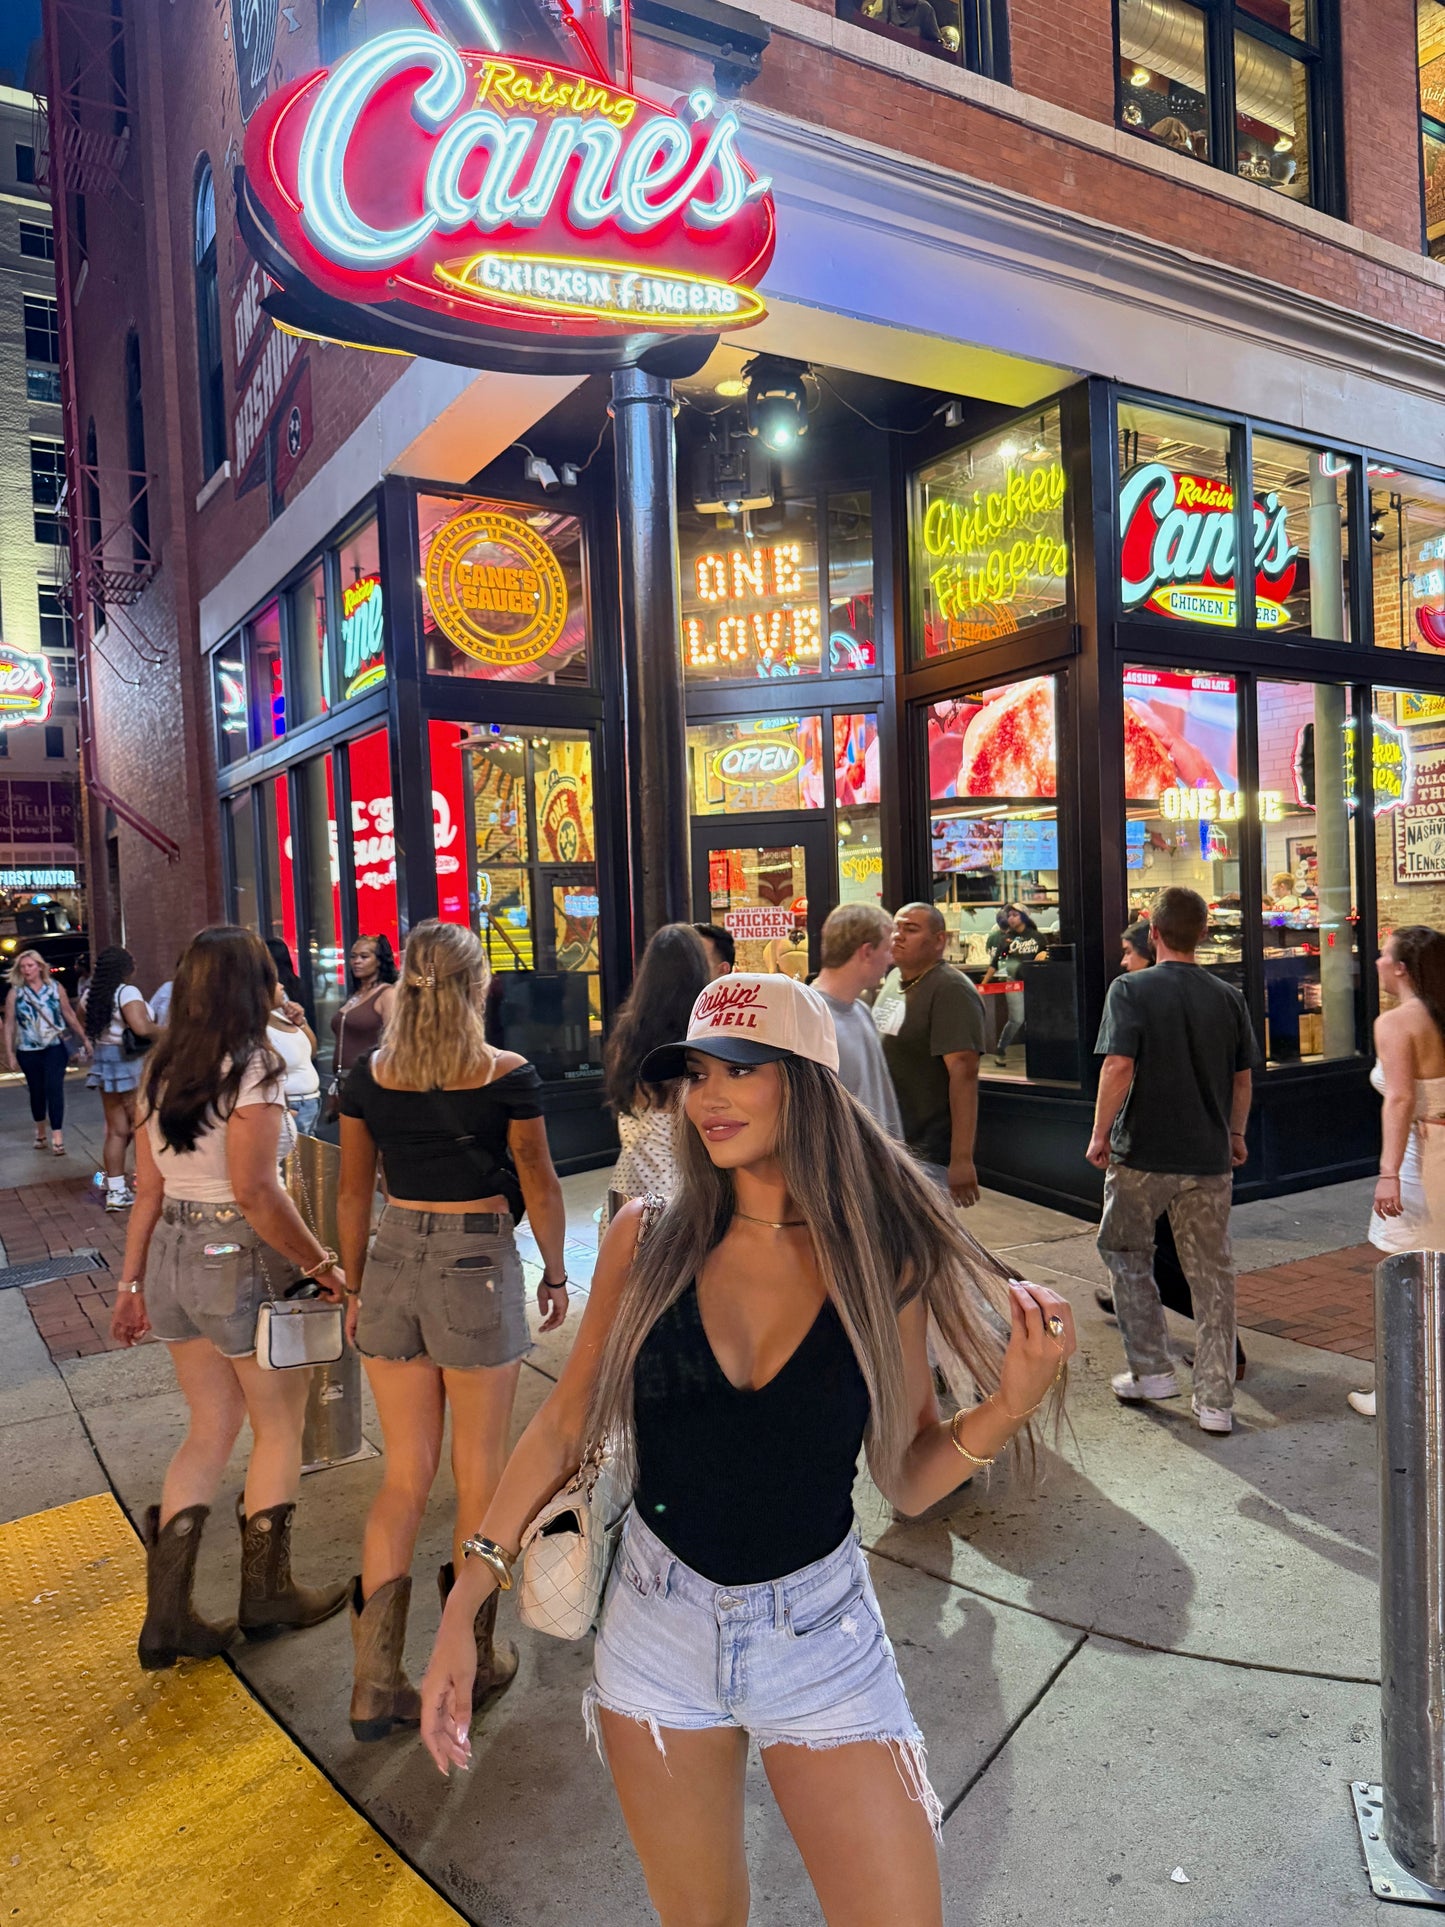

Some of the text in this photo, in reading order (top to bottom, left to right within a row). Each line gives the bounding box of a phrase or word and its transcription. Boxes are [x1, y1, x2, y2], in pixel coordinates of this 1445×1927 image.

[480, 61, 638, 129] Raising
[298, 28, 774, 268] Cane's
[479, 257, 739, 314] CHICKEN FINGERS
[235, 261, 262, 367] ONE
[923, 463, 1067, 556] Chicken
[457, 563, 538, 592] CANE'S
[695, 544, 801, 602] ONE
[930, 533, 1069, 620] Fingers
[462, 587, 537, 614] SAUCE
[1170, 593, 1223, 617] CHICKEN
[683, 607, 822, 666] LOVE
[1191, 678, 1230, 691] OPEN LATE
[722, 745, 797, 774] OPEN
[730, 782, 776, 809] 212
[1160, 787, 1217, 820] ONE
[549, 793, 569, 831] ONE
[32, 870, 76, 886] WATCH
[726, 913, 793, 927] CHICKEN
[733, 927, 786, 938] FINGERS
[709, 1013, 758, 1028] HELL
